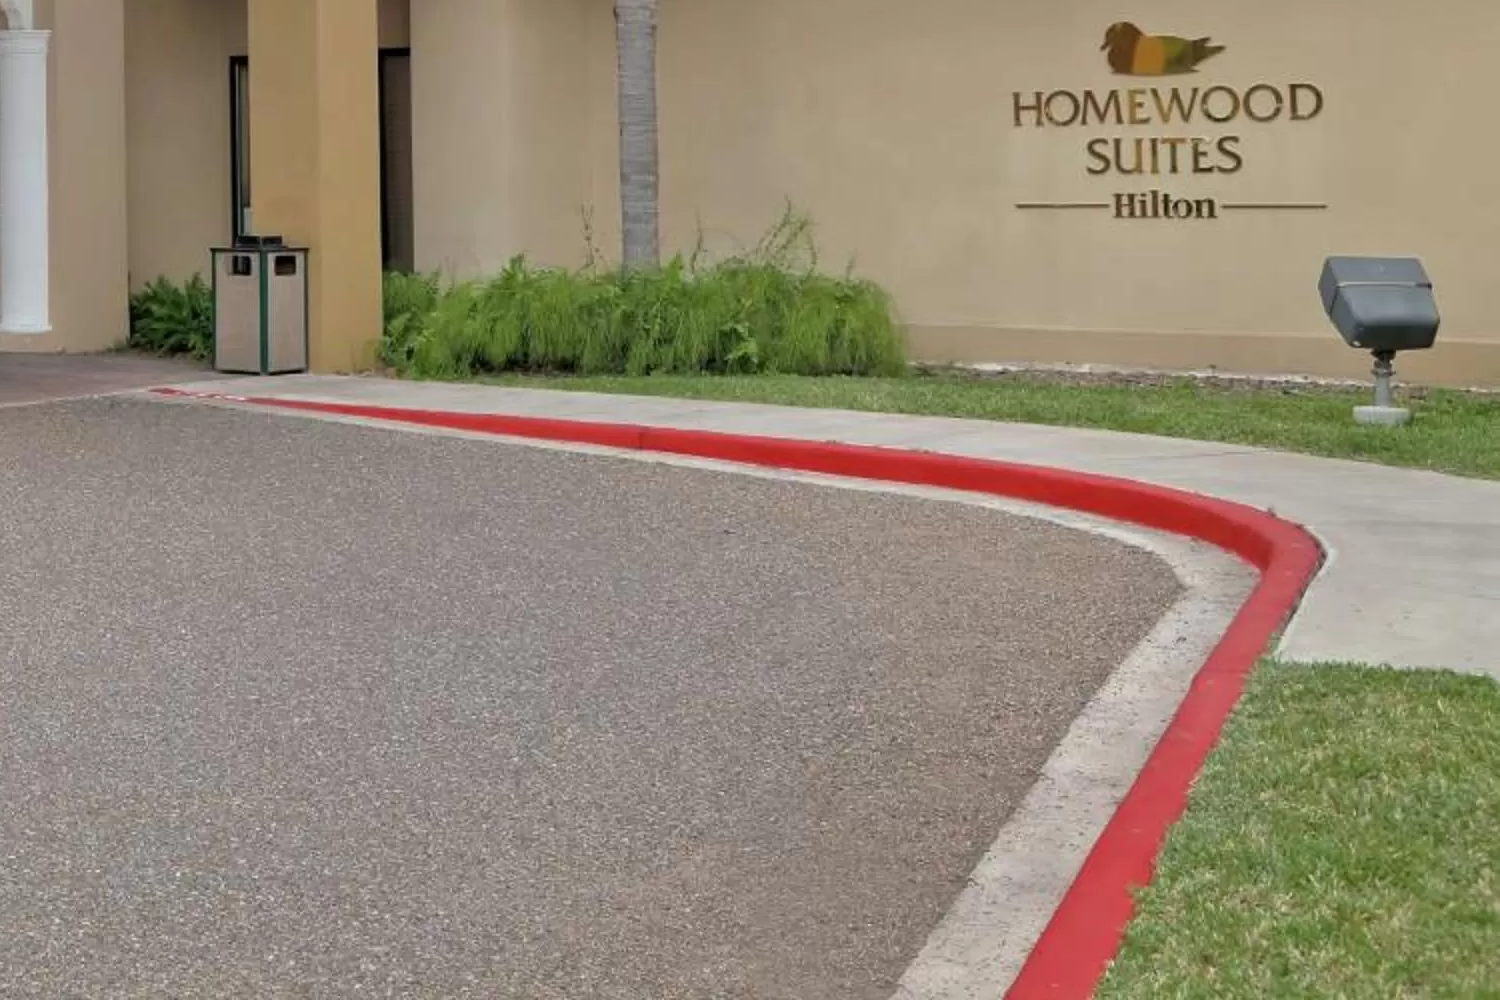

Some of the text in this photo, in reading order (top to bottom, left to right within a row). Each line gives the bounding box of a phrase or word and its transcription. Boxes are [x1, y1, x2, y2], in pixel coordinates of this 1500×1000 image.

[1012, 83, 1324, 127] HOMEWOOD
[1086, 135, 1243, 175] SUITES
[1112, 190, 1218, 220] Hilton
